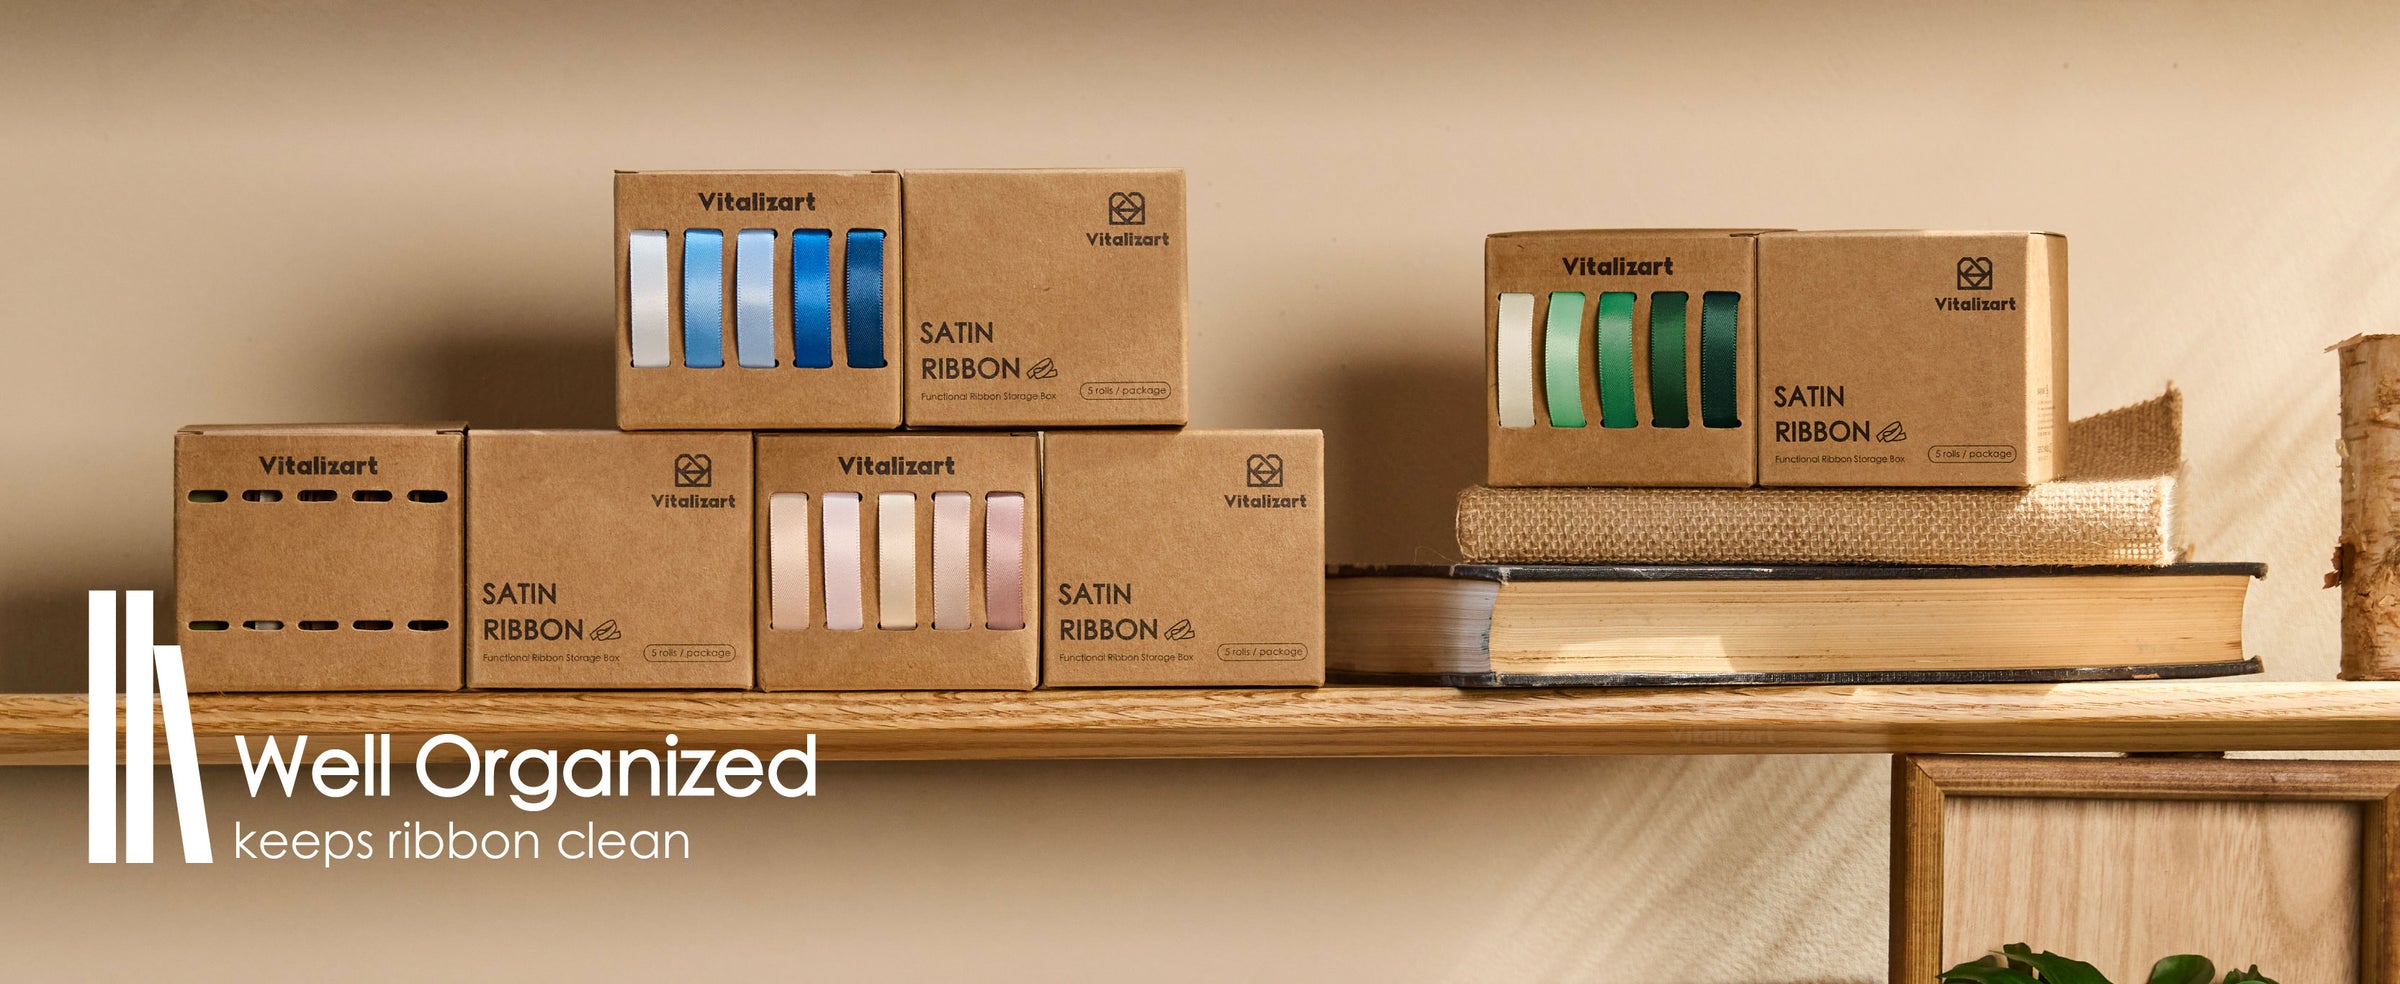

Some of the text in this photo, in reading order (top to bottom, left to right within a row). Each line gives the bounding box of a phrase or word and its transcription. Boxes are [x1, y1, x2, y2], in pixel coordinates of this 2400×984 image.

[698, 193, 815, 211] Vitalizart
[1087, 233, 1169, 246] Vitalizart
[1562, 257, 1673, 276] Vitalizart
[1935, 298, 2016, 311] Vitalizart
[920, 322, 992, 344] SATIN
[922, 357, 1019, 380] RIBBON
[921, 392, 1056, 402] Functional Ribbon Storage Box
[1088, 386, 1094, 395] 5
[1095, 386, 1114, 395] rolls
[1122, 386, 1167, 397] package
[1774, 385, 1844, 408] SATIN
[1776, 420, 1869, 443] RIBBON
[1775, 455, 1905, 465] Functional Ribbon Storage Box
[1935, 449, 1942, 458] 5
[1943, 449, 1960, 458] rolls
[1969, 449, 2012, 460] package
[259, 456, 378, 476] Vitalizart
[838, 456, 955, 476] Vitalizart
[651, 494, 736, 509] Vitalizart
[1224, 494, 1307, 509] Vitalizart
[483, 583, 557, 605] SATIN
[1058, 583, 1131, 605] SATIN
[484, 619, 583, 641] RIBBON
[1060, 619, 1158, 641] RIBBON
[483, 653, 620, 664] Functional Ribbon Storage Box
[651, 648, 657, 657] 5
[658, 648, 677, 657] rolls
[686, 648, 732, 659] package
[1059, 653, 1193, 663] Functional Ribbon Storage Box
[1225, 648, 1230, 656] 5
[1232, 648, 1250, 656] rolls
[1258, 648, 1303, 658] package
